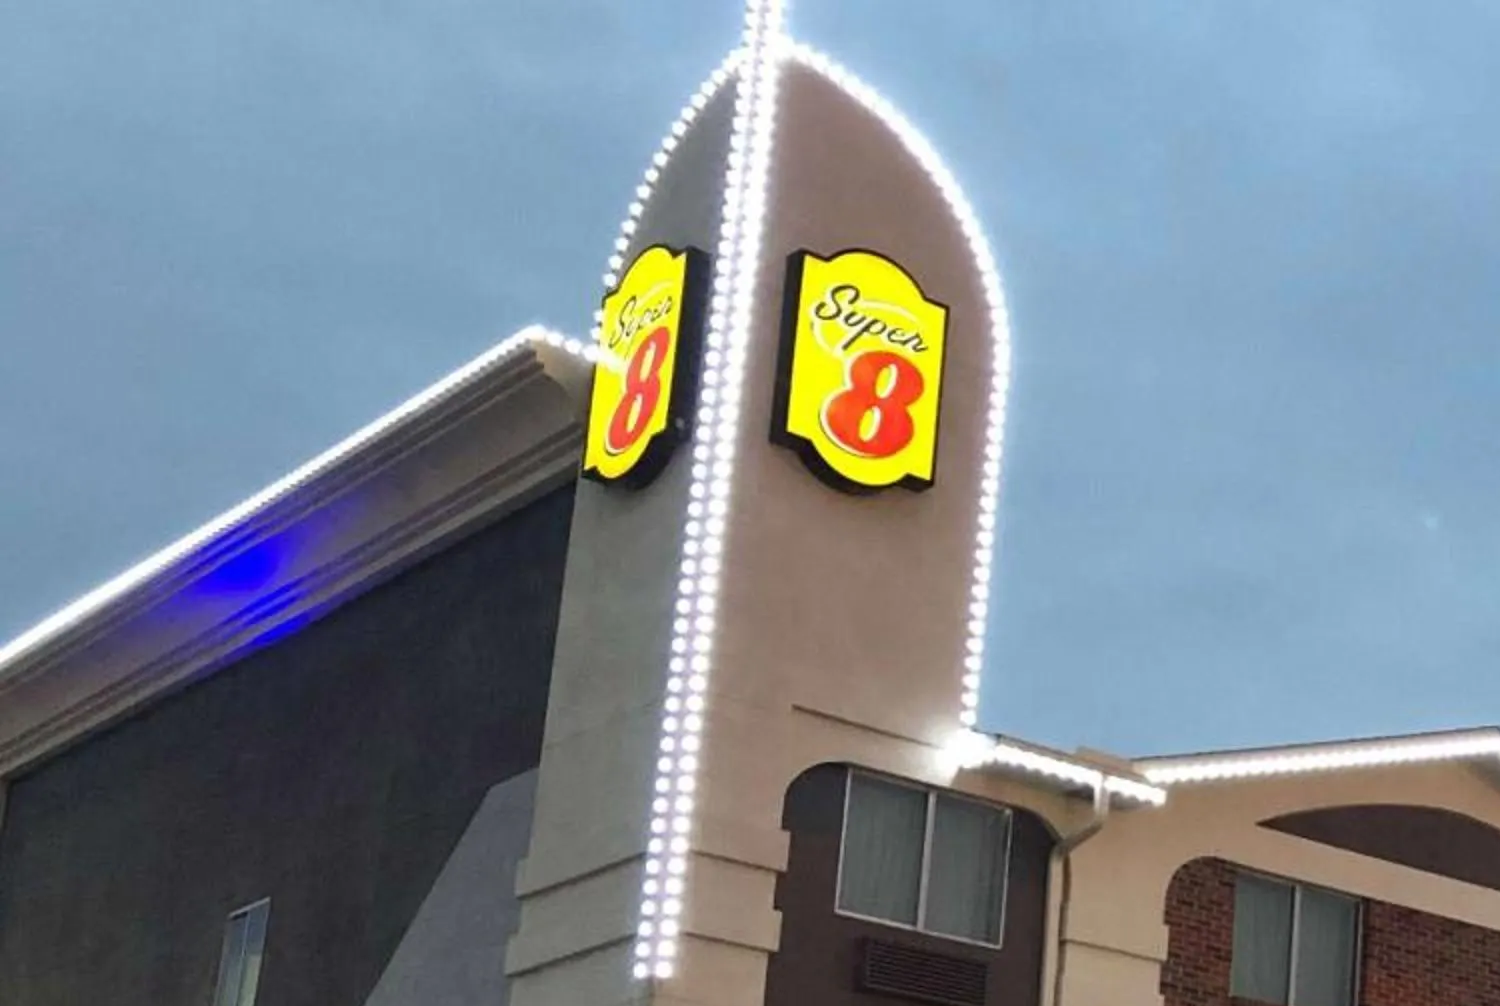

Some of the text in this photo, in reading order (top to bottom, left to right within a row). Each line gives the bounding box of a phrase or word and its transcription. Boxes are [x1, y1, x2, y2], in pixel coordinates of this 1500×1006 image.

[815, 285, 928, 353] Super
[606, 326, 670, 456] 8
[820, 350, 925, 458] 8
